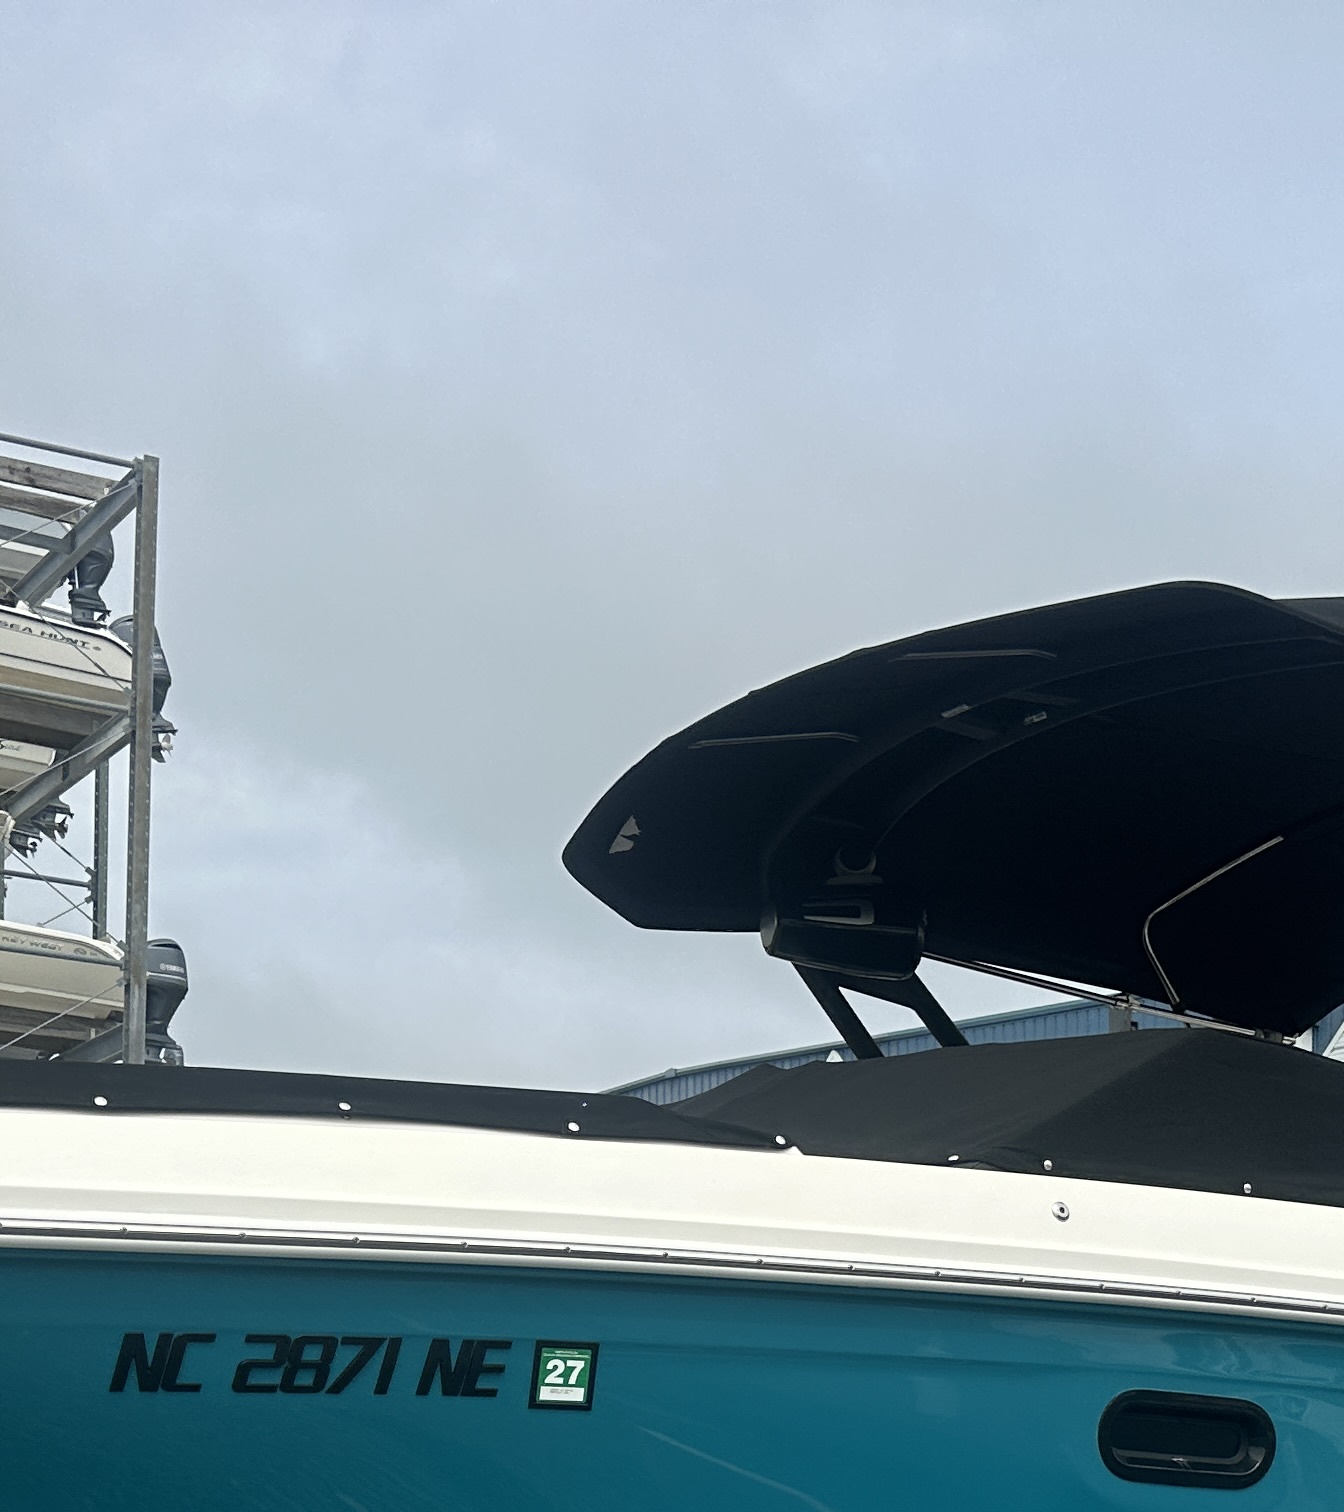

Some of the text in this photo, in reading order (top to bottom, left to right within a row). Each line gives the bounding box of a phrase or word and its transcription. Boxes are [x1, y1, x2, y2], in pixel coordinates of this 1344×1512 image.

[109, 1332, 513, 1398] NC 2871 NE
[544, 1358, 586, 1385] 27
